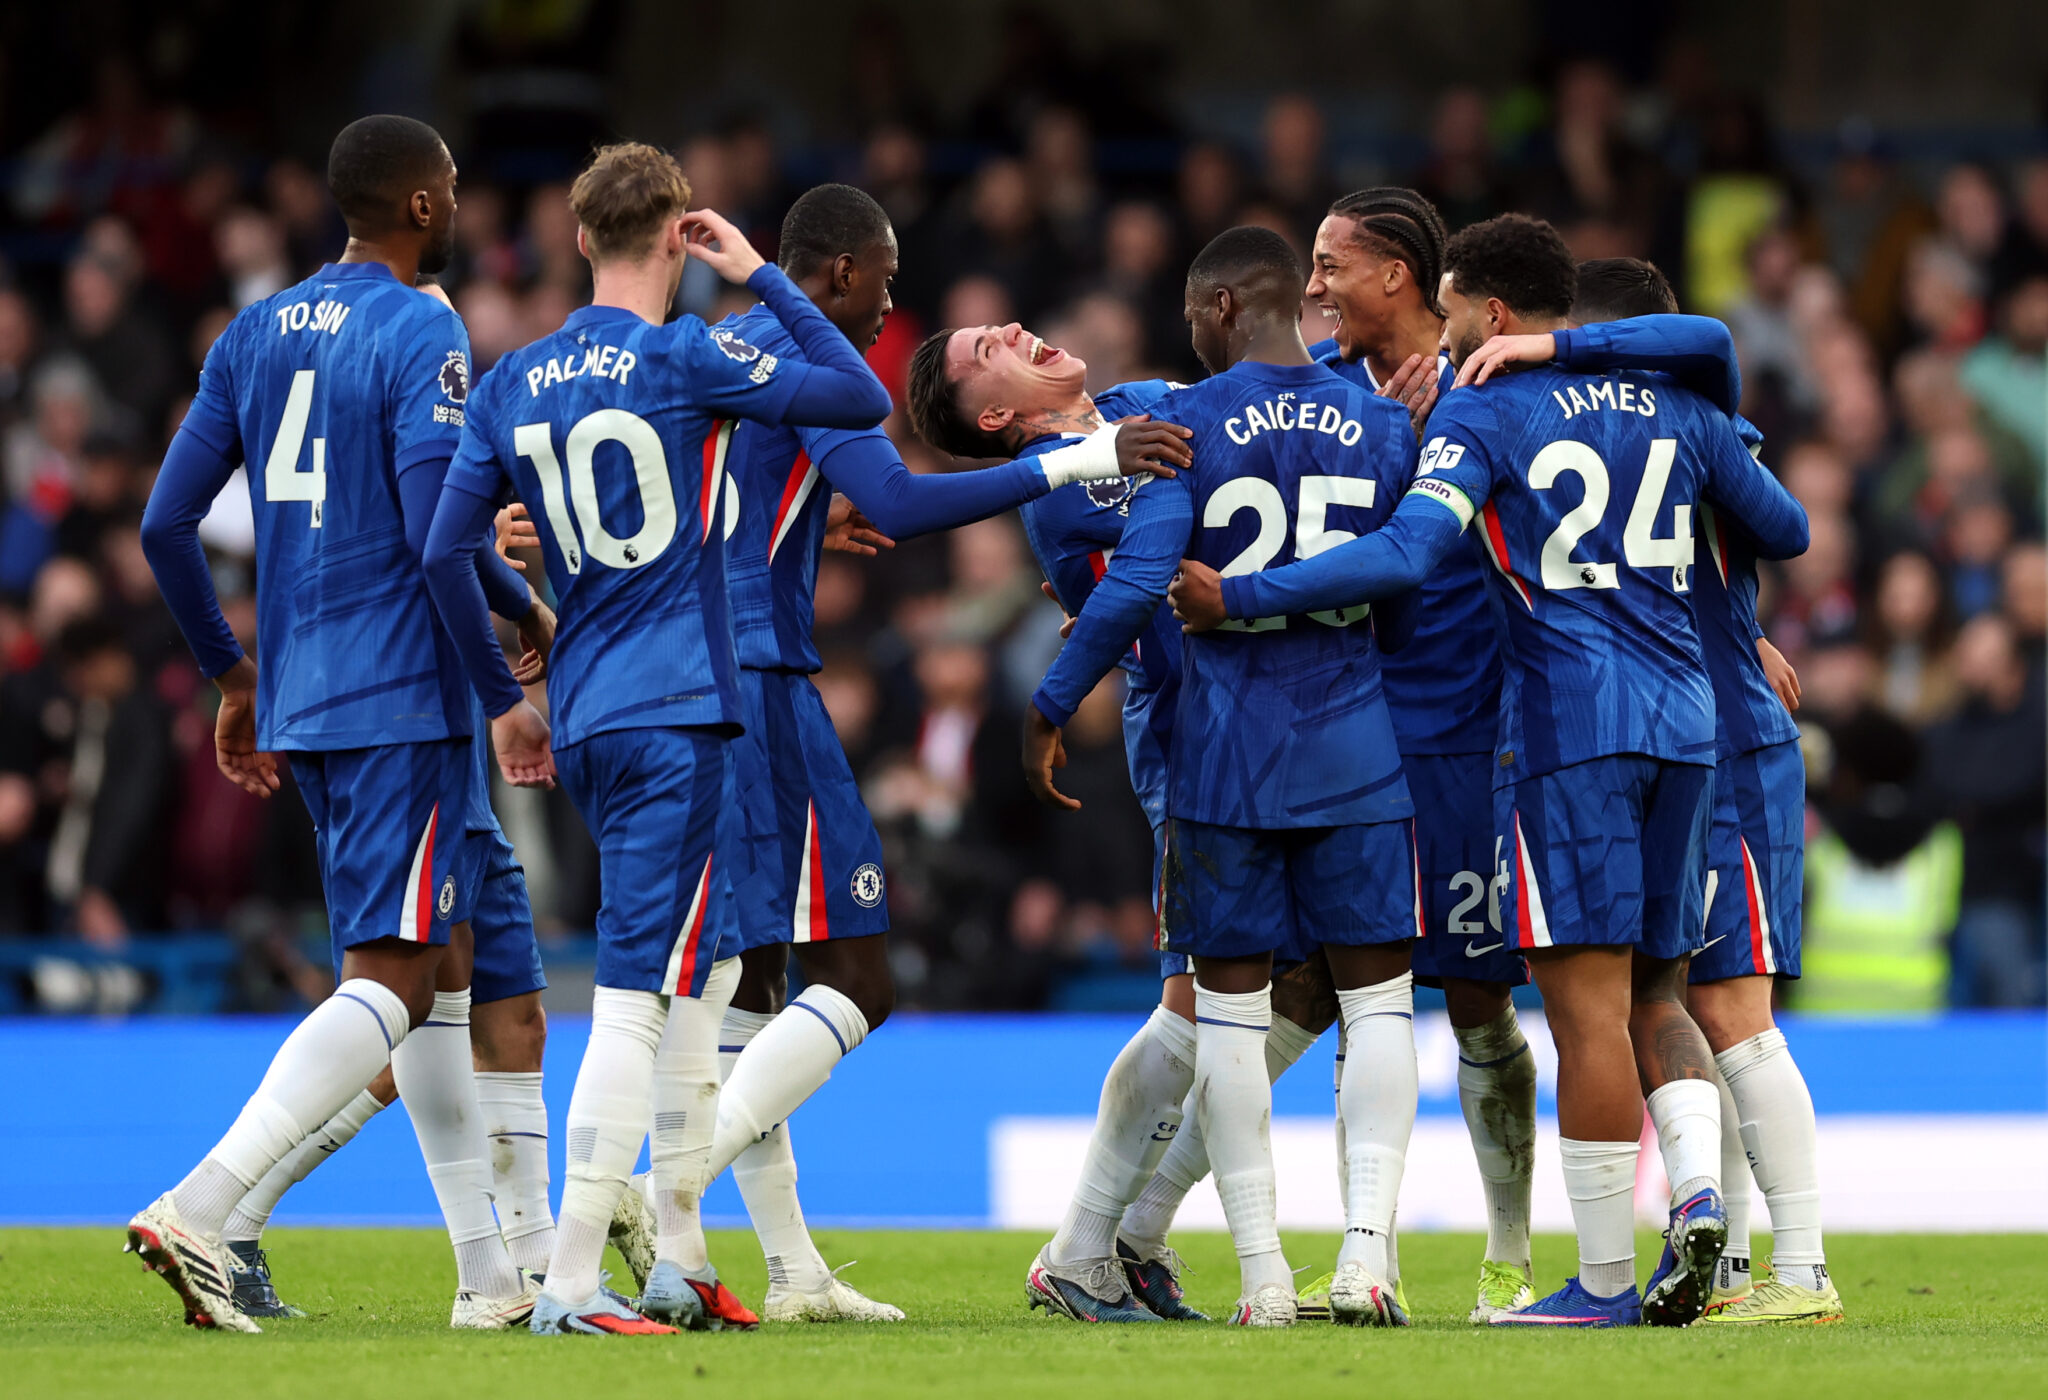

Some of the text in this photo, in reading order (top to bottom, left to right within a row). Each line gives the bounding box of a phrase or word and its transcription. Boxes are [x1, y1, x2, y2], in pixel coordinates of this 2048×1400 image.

[277, 301, 351, 336] TOSIN
[526, 344, 637, 398] PALMER
[434, 403, 450, 415] No
[1278, 392, 1296, 401] CFC
[1552, 383, 1657, 419] JAMES
[1224, 400, 1363, 446] CAICEDO
[265, 370, 327, 528] 4
[514, 408, 677, 575] 10
[1527, 439, 1695, 592] 24
[1203, 475, 1376, 632] 25
